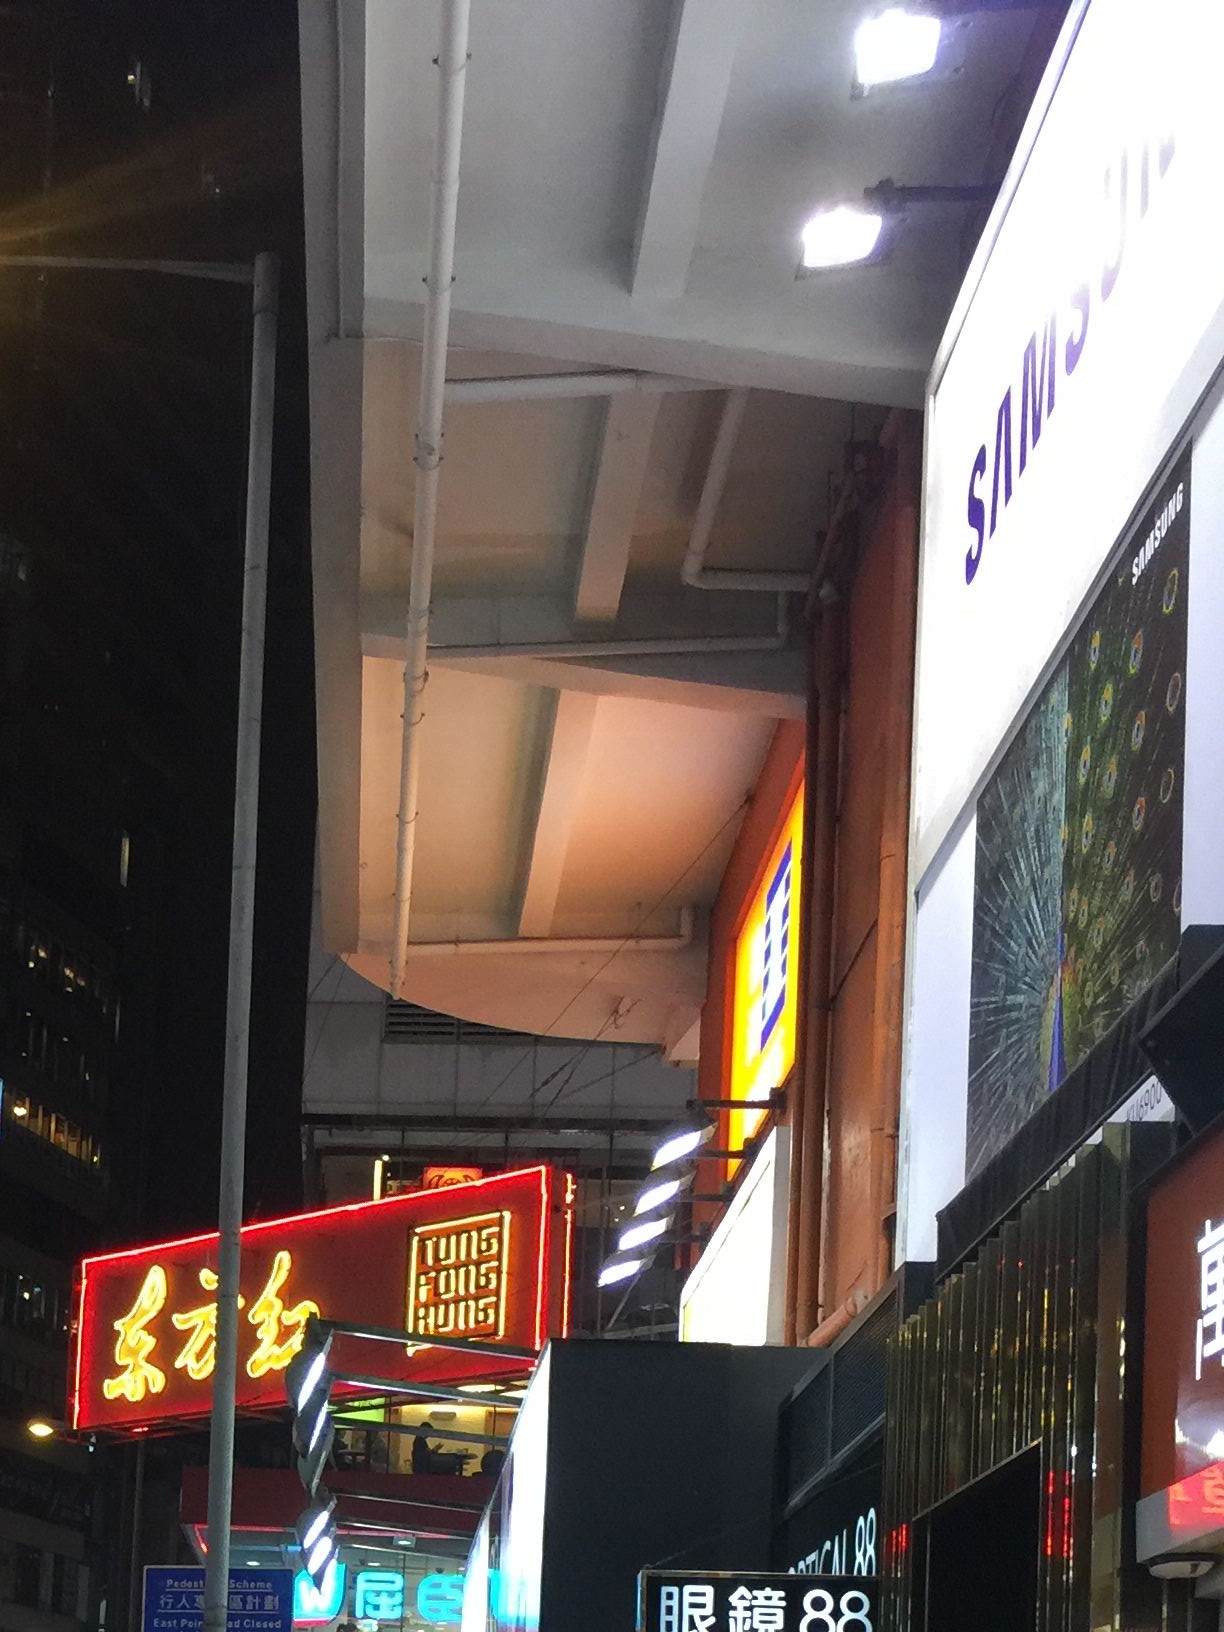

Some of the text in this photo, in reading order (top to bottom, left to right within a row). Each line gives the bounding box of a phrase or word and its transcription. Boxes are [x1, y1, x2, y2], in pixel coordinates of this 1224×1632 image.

[1131, 482, 1184, 586] SAMSUNG
[424, 1226, 499, 1267] TUNG
[419, 1260, 499, 1303] FONG
[229, 1579, 273, 1589] Scheme
[153, 1618, 178, 1629] East
[243, 1618, 282, 1629] Closed
